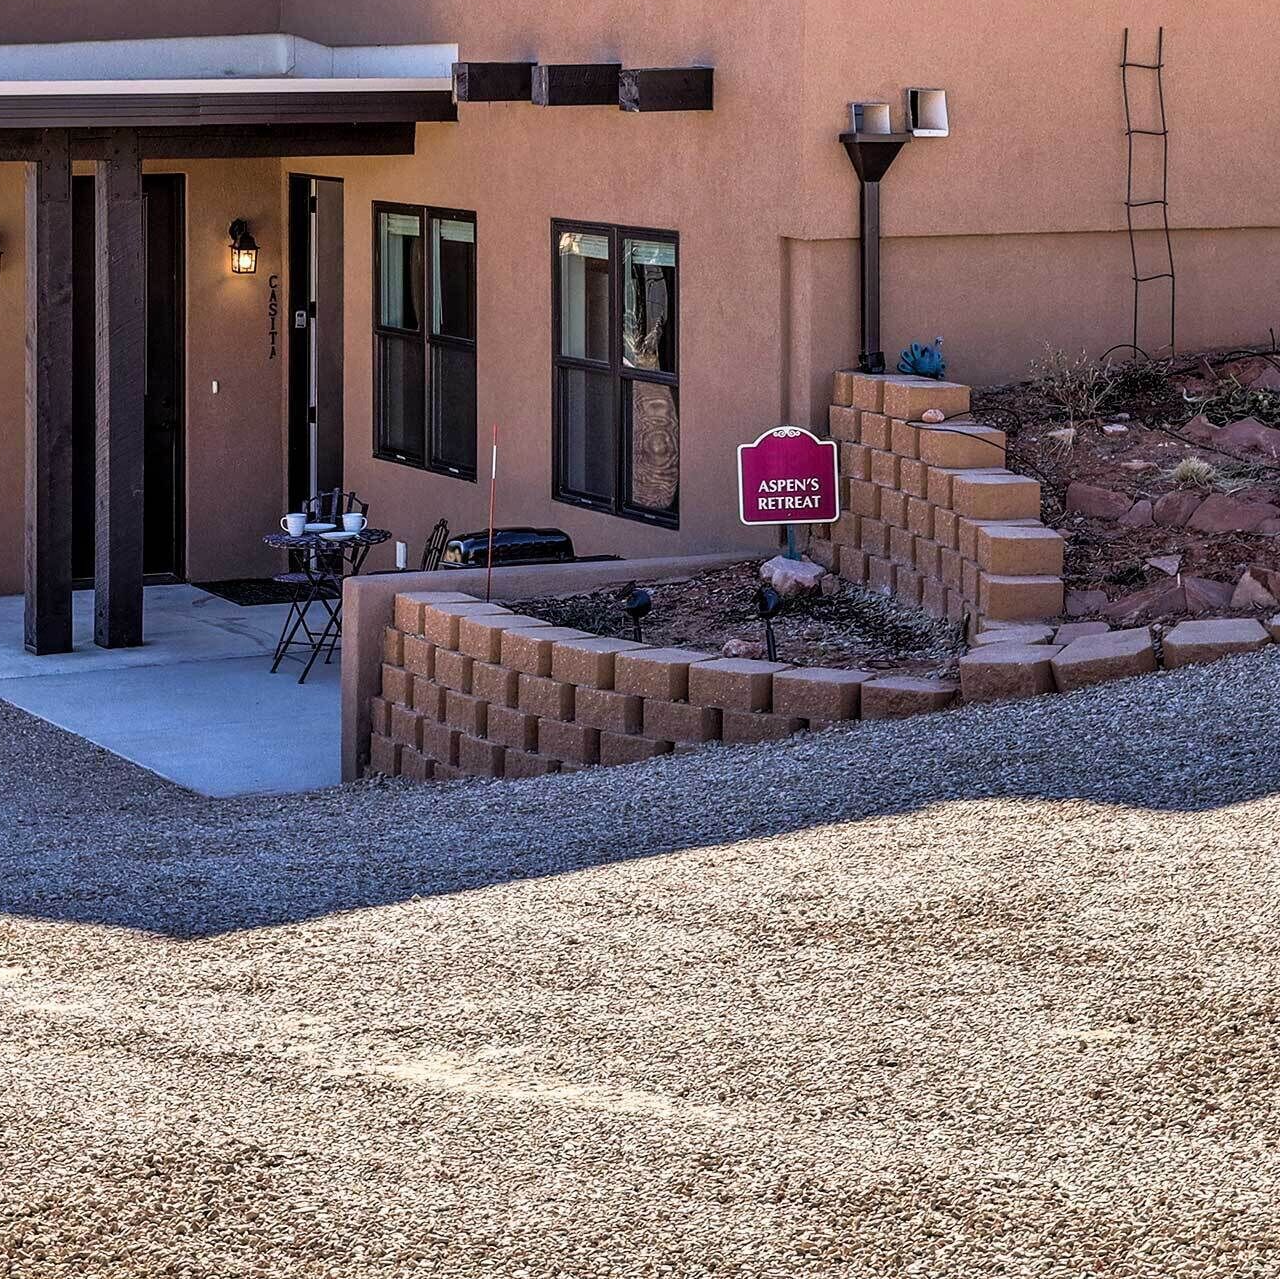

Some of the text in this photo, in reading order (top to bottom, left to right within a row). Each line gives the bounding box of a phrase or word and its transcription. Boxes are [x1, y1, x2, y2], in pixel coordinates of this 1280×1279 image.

[268, 275, 278, 360] CASITA
[758, 477, 820, 493] ASPEN'S
[758, 495, 822, 510] RETREAT
